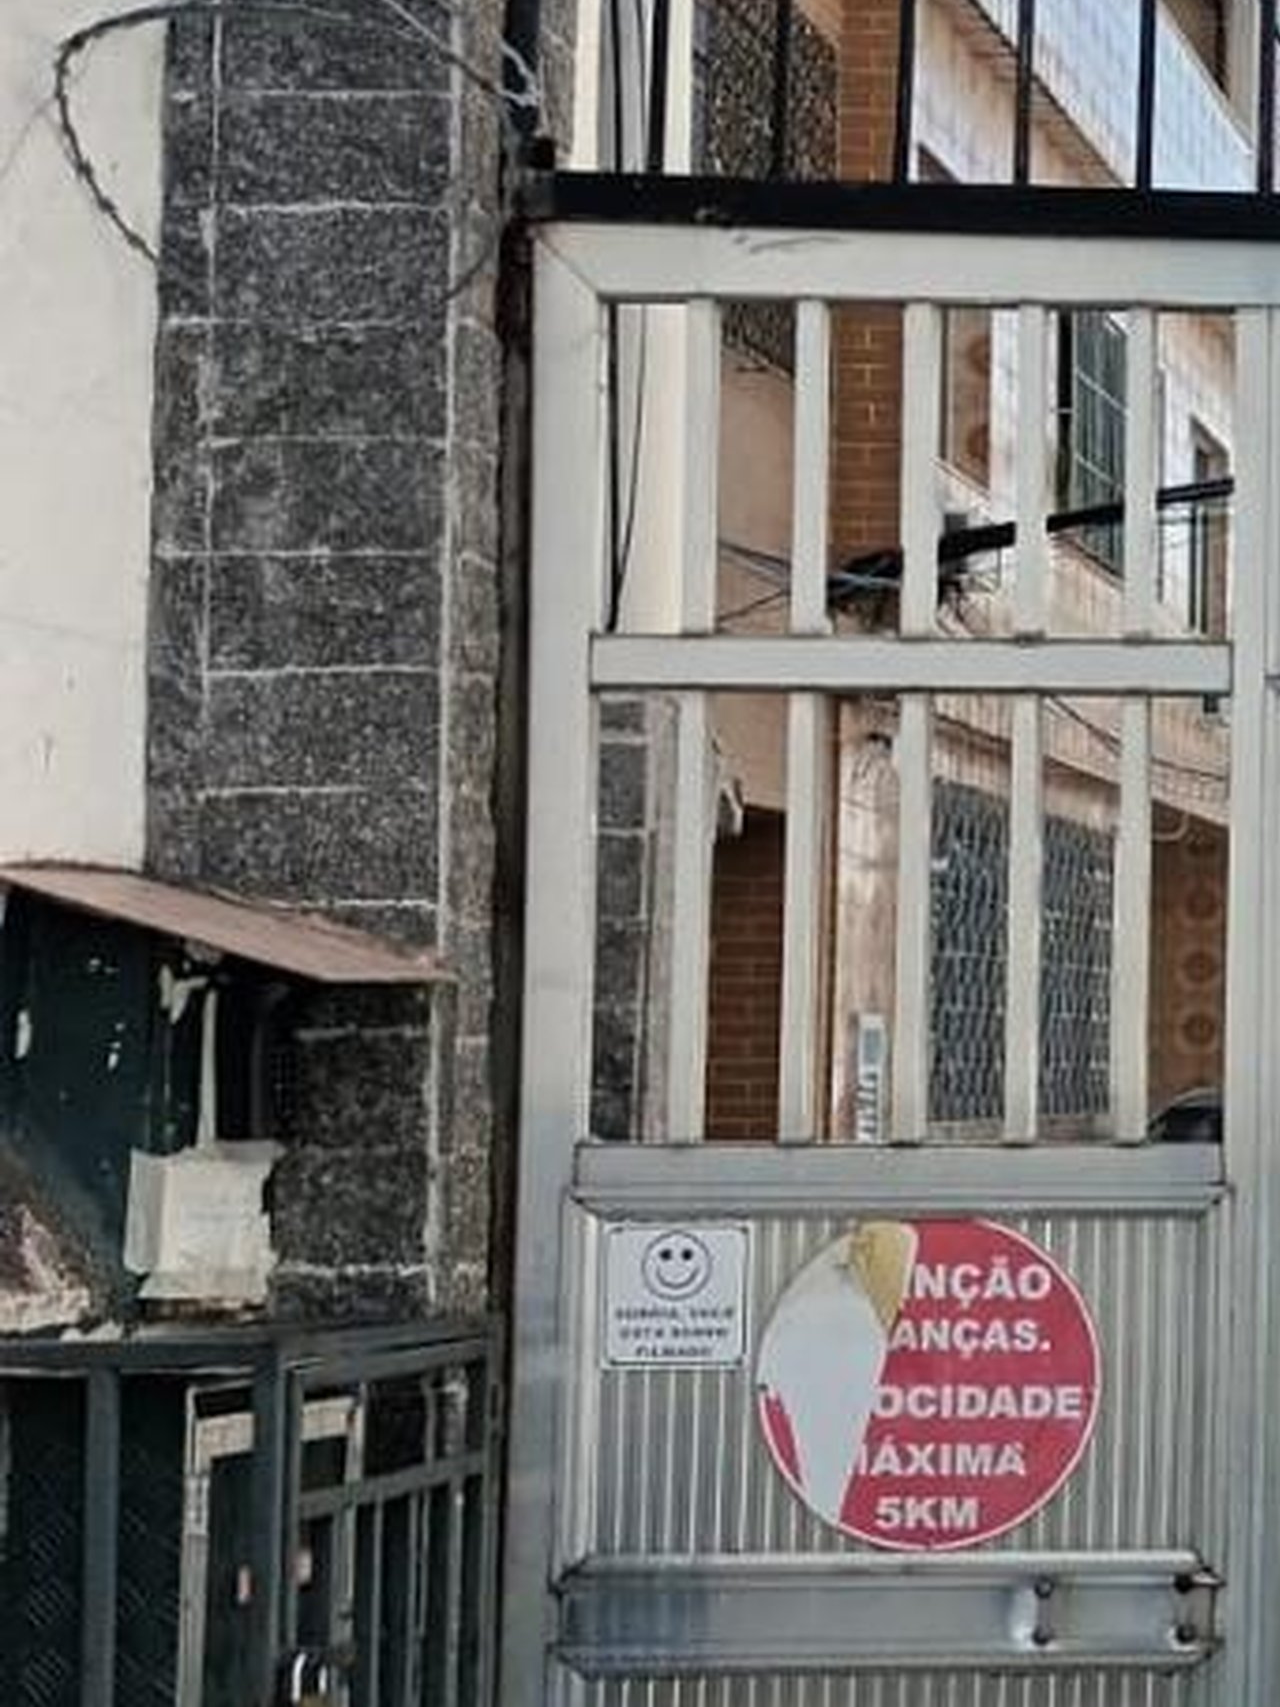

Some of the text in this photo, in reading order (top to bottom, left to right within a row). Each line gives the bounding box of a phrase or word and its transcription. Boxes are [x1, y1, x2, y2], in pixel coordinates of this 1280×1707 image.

[889, 1320, 1051, 1359] ANÇAS.
[874, 1385, 1081, 1418] OCIDADE
[875, 1497, 978, 1529] 5KM
